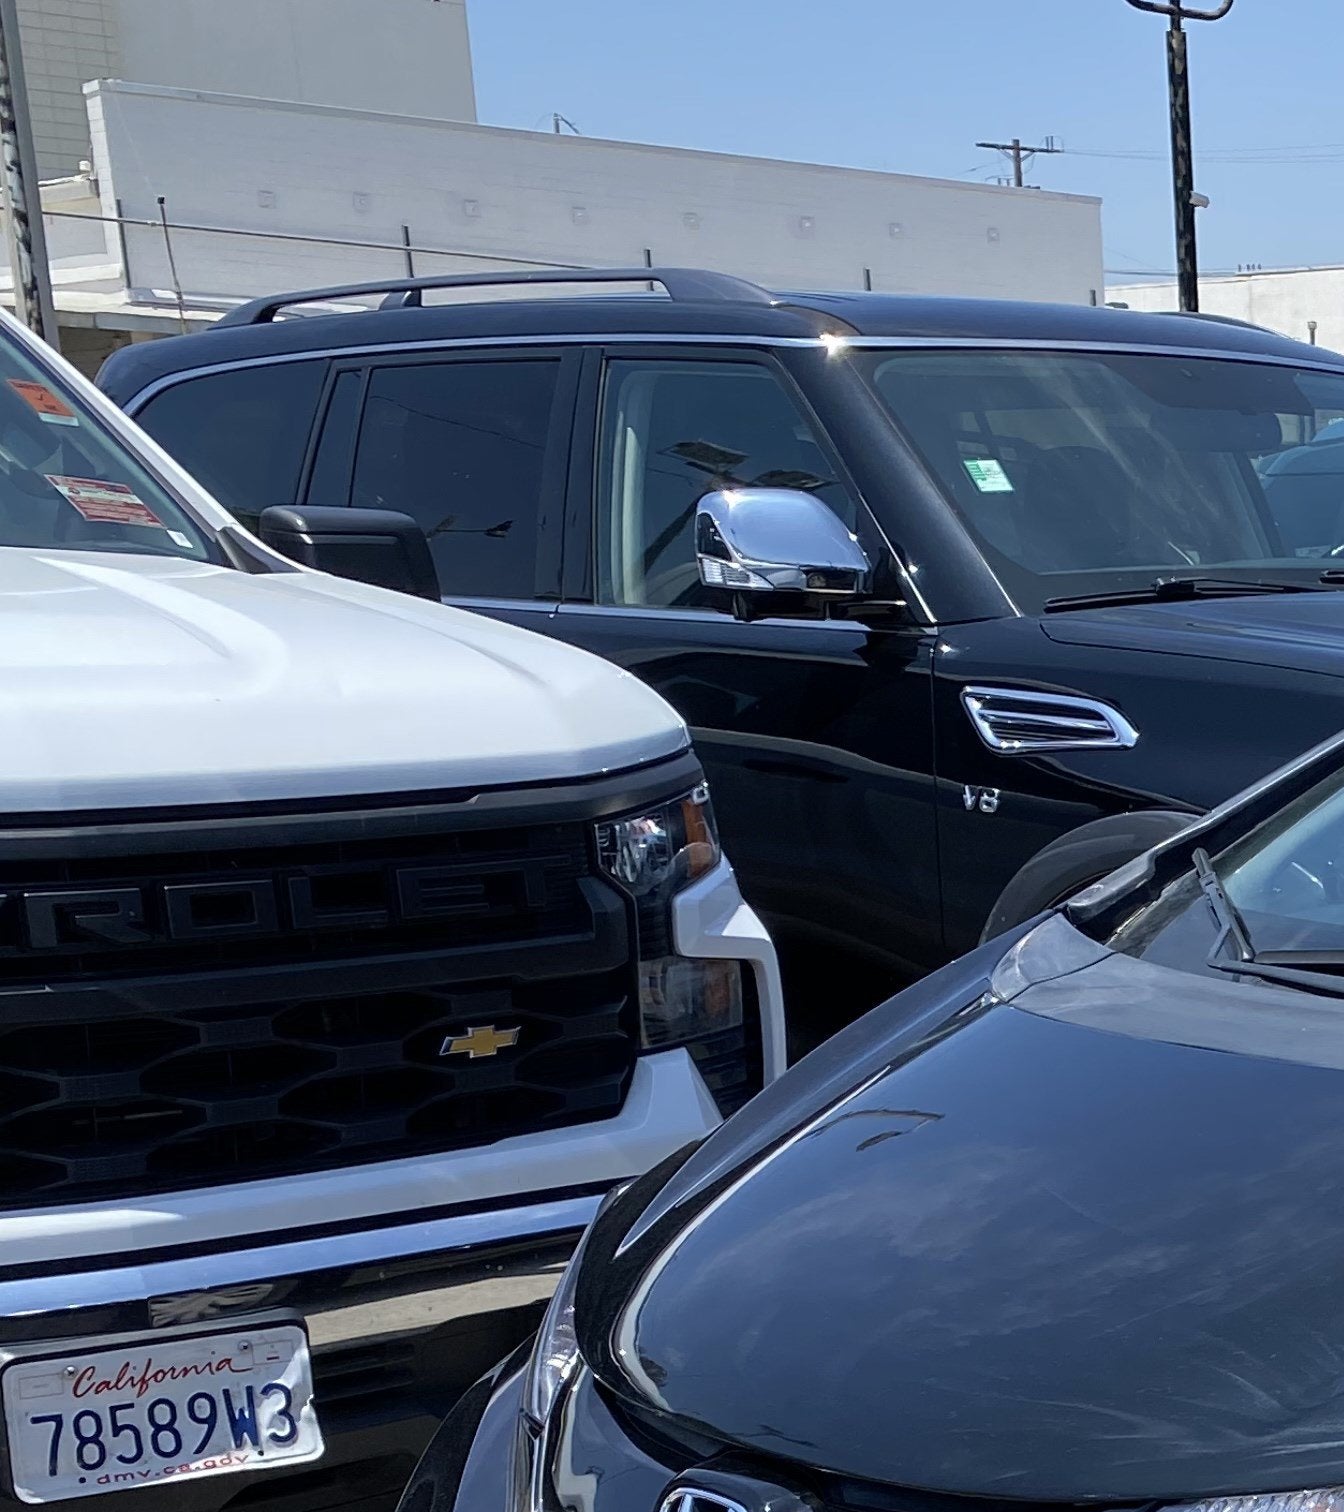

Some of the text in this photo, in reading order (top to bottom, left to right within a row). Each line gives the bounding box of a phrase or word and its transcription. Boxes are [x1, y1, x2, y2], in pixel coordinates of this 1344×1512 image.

[962, 784, 1000, 813] V8
[0, 854, 572, 949] ROLET
[72, 1356, 252, 1397] California
[29, 1381, 298, 1477] 78589W3
[95, 1453, 250, 1486] dmv.ca.gov
